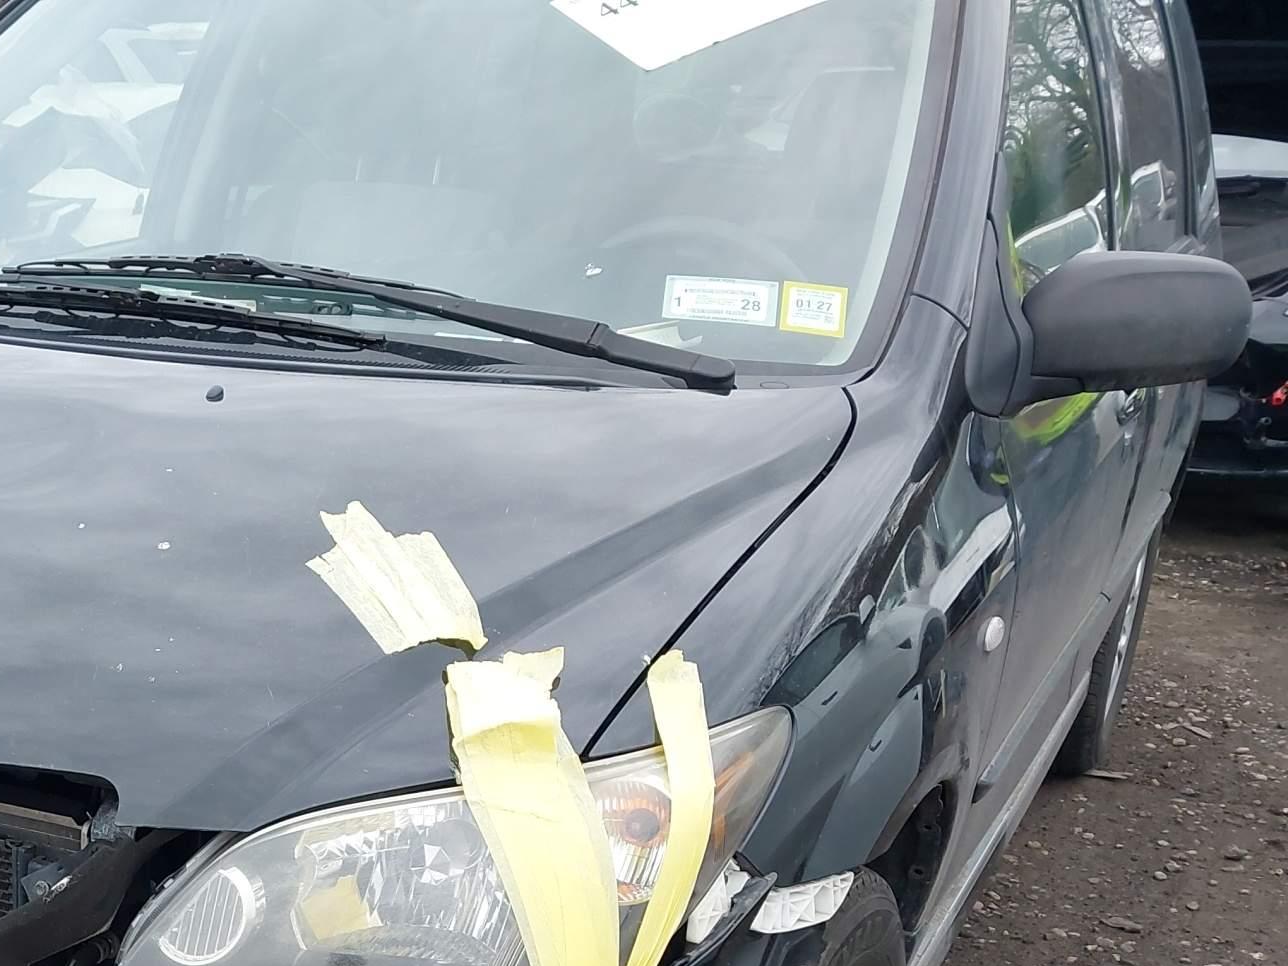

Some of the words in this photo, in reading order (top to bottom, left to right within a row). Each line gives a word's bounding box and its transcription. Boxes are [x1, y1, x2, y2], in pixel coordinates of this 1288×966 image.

[674, 295, 682, 308] 1
[740, 298, 762, 312] 28
[795, 298, 812, 309] 01
[816, 300, 833, 312] 27
